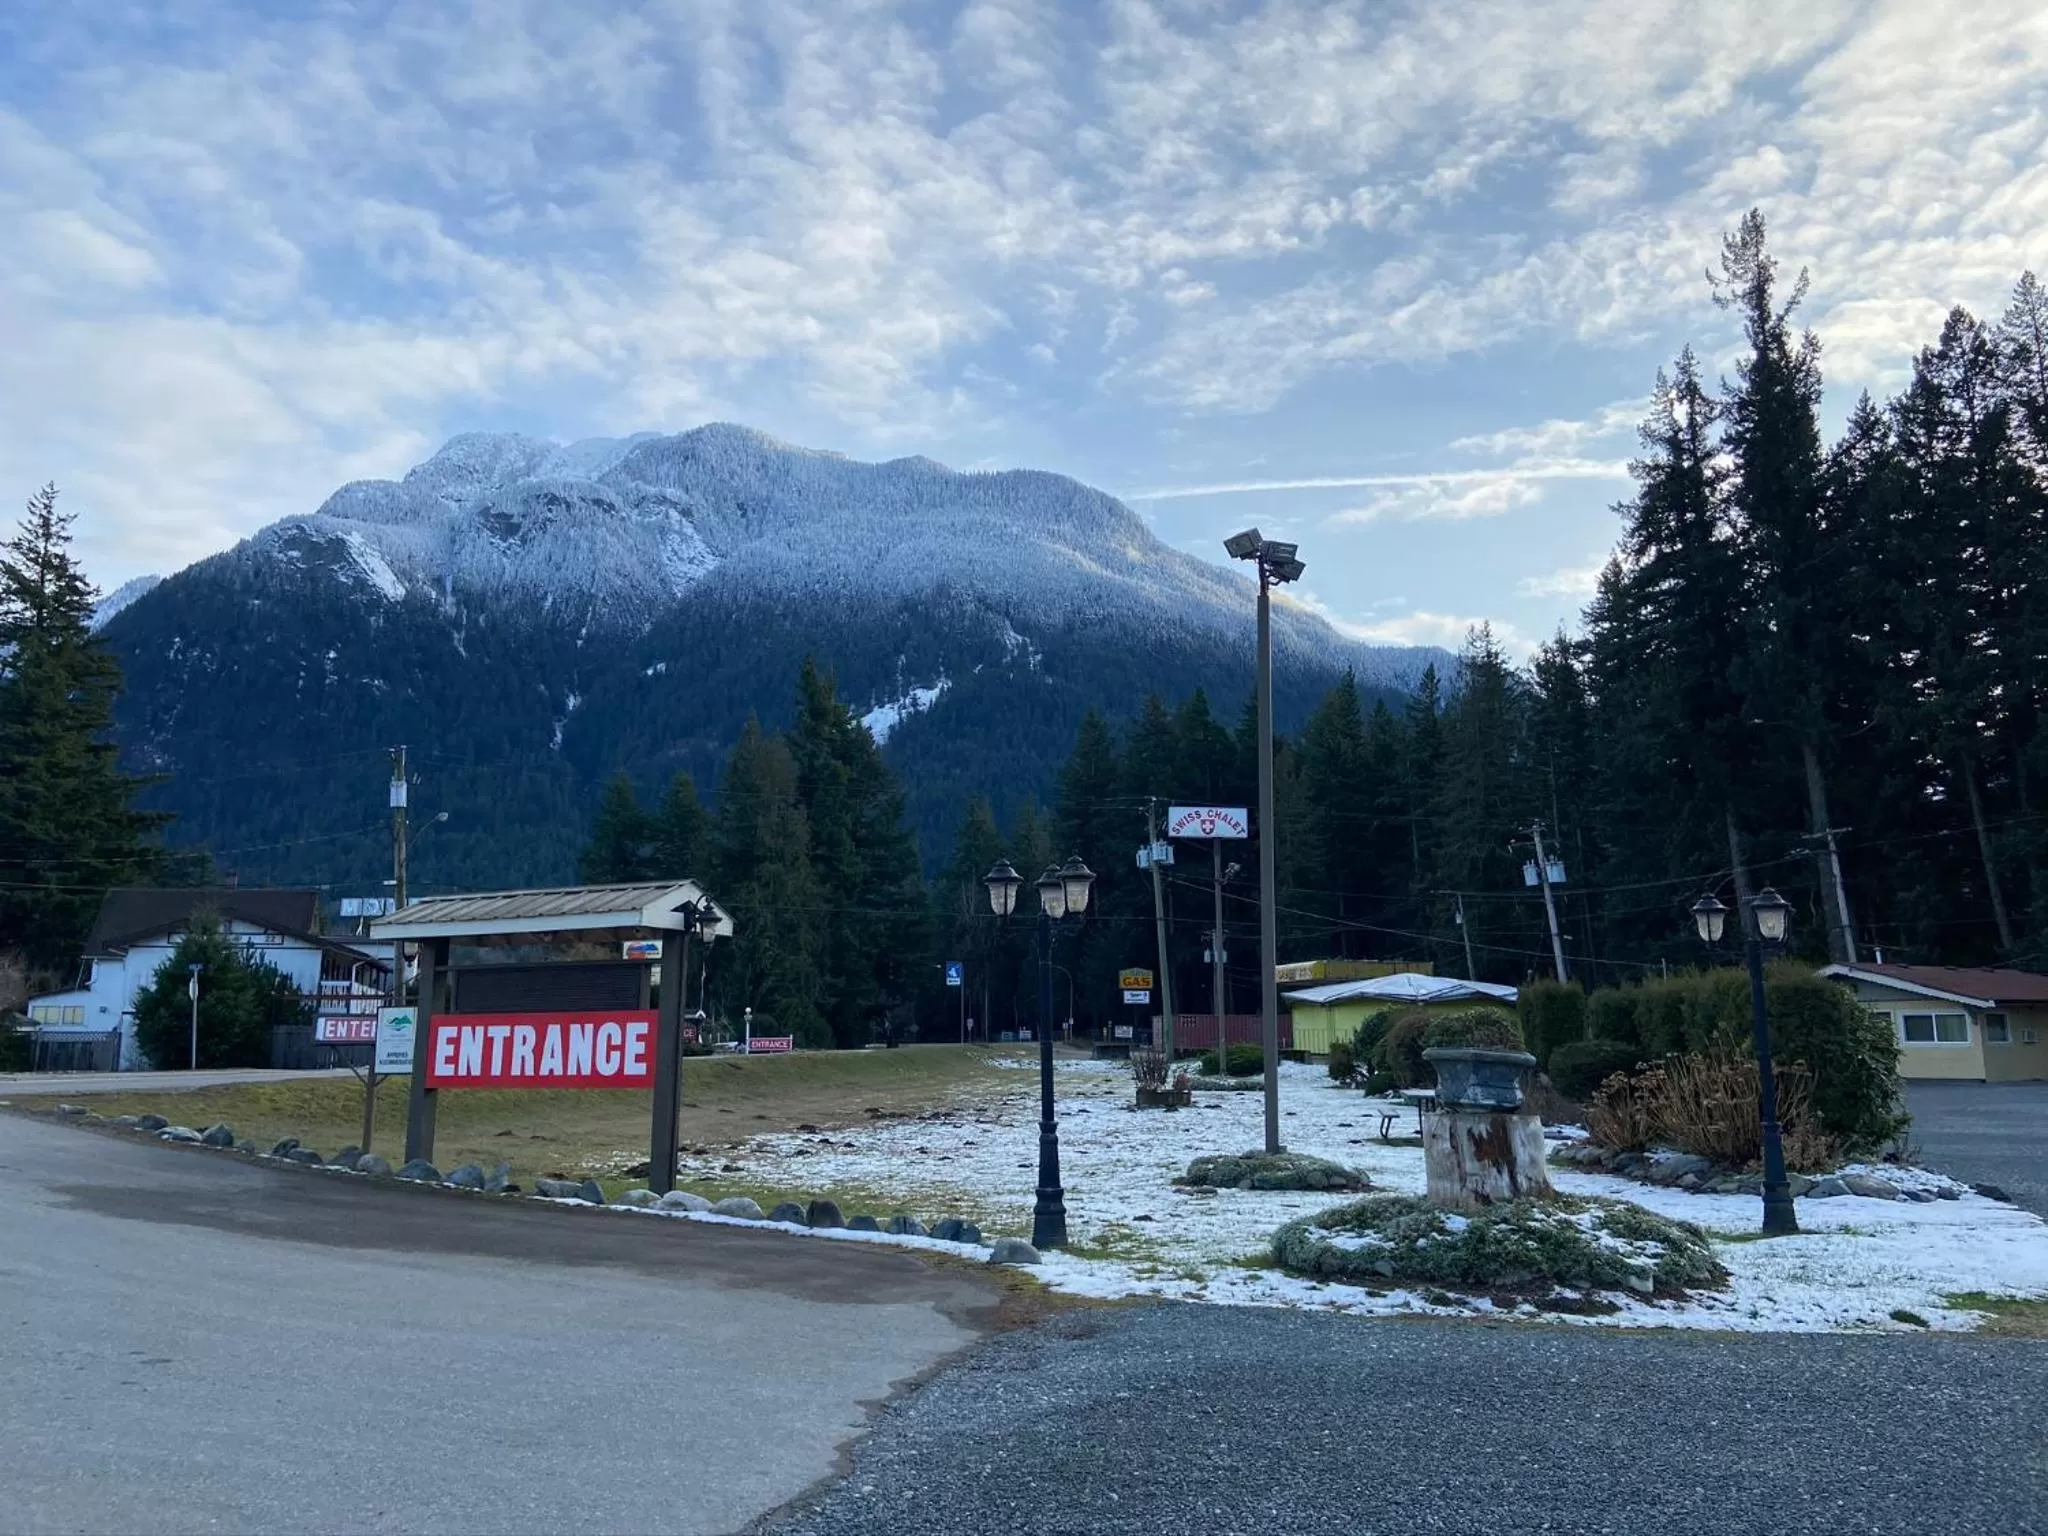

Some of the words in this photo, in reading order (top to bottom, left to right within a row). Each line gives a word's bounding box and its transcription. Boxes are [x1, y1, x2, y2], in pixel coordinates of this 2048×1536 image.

[1172, 810, 1202, 834] SWISS
[1207, 809, 1246, 834] CHALET
[1122, 976, 1151, 987] GAS
[434, 1021, 649, 1077] ENTRANCE
[751, 1039, 789, 1049] ENTRANCE
